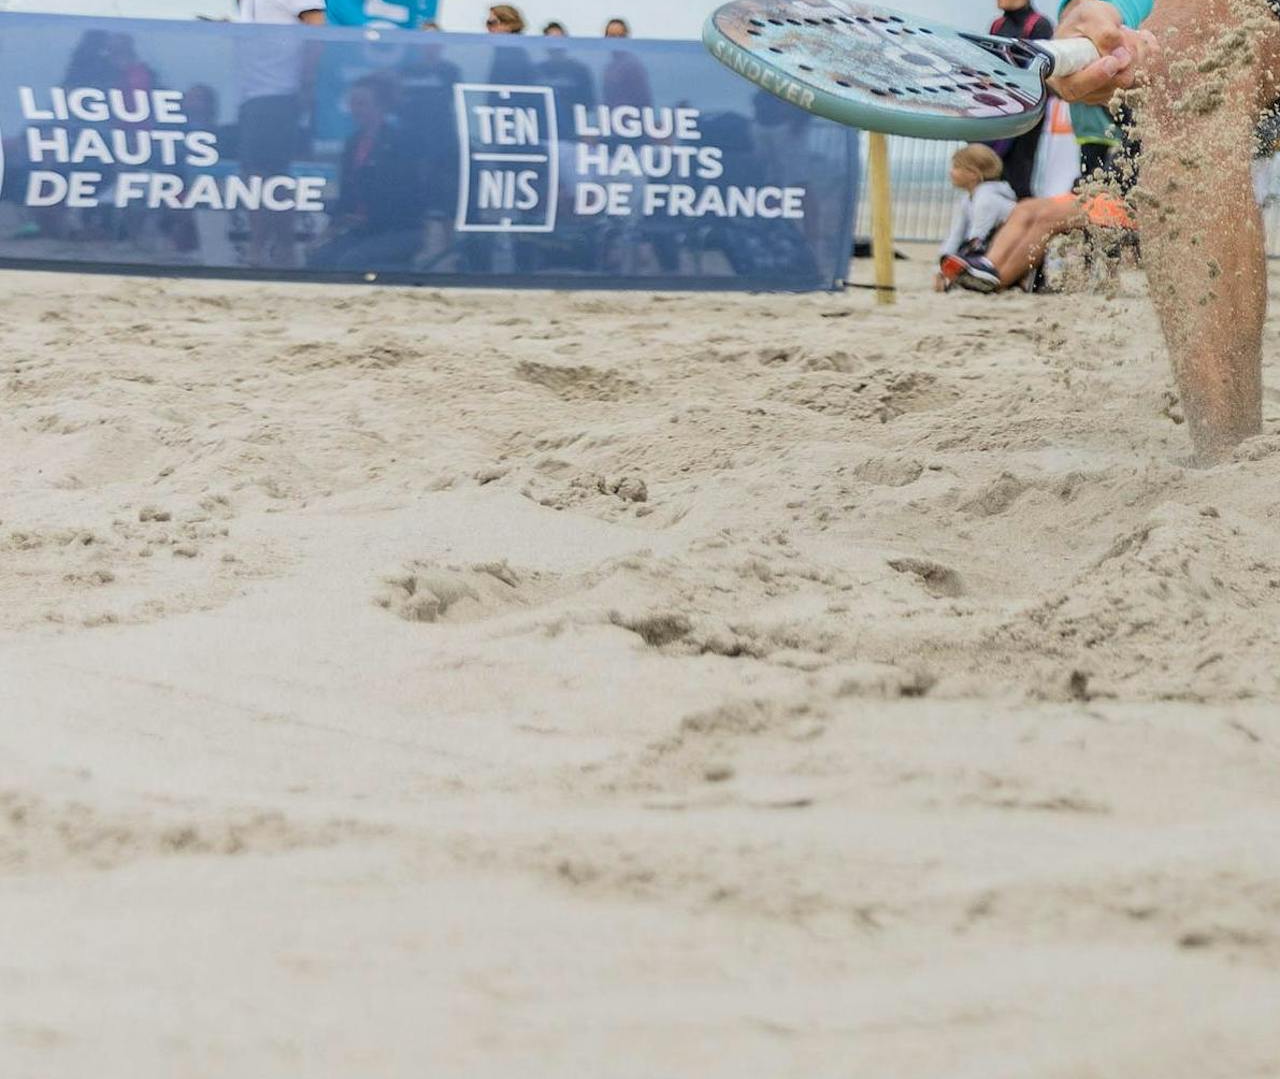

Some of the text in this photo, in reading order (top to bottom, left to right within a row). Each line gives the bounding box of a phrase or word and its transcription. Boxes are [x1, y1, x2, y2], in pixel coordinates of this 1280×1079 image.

[18, 86, 188, 123] LIGUE
[573, 104, 701, 140] LIGUE
[473, 106, 539, 146] TEN
[27, 127, 219, 167] HAUTS
[574, 143, 723, 180] HAUTS
[25, 170, 327, 212] DE FRANCE
[478, 169, 539, 210] NIS
[575, 182, 806, 219] DE FRANCE
